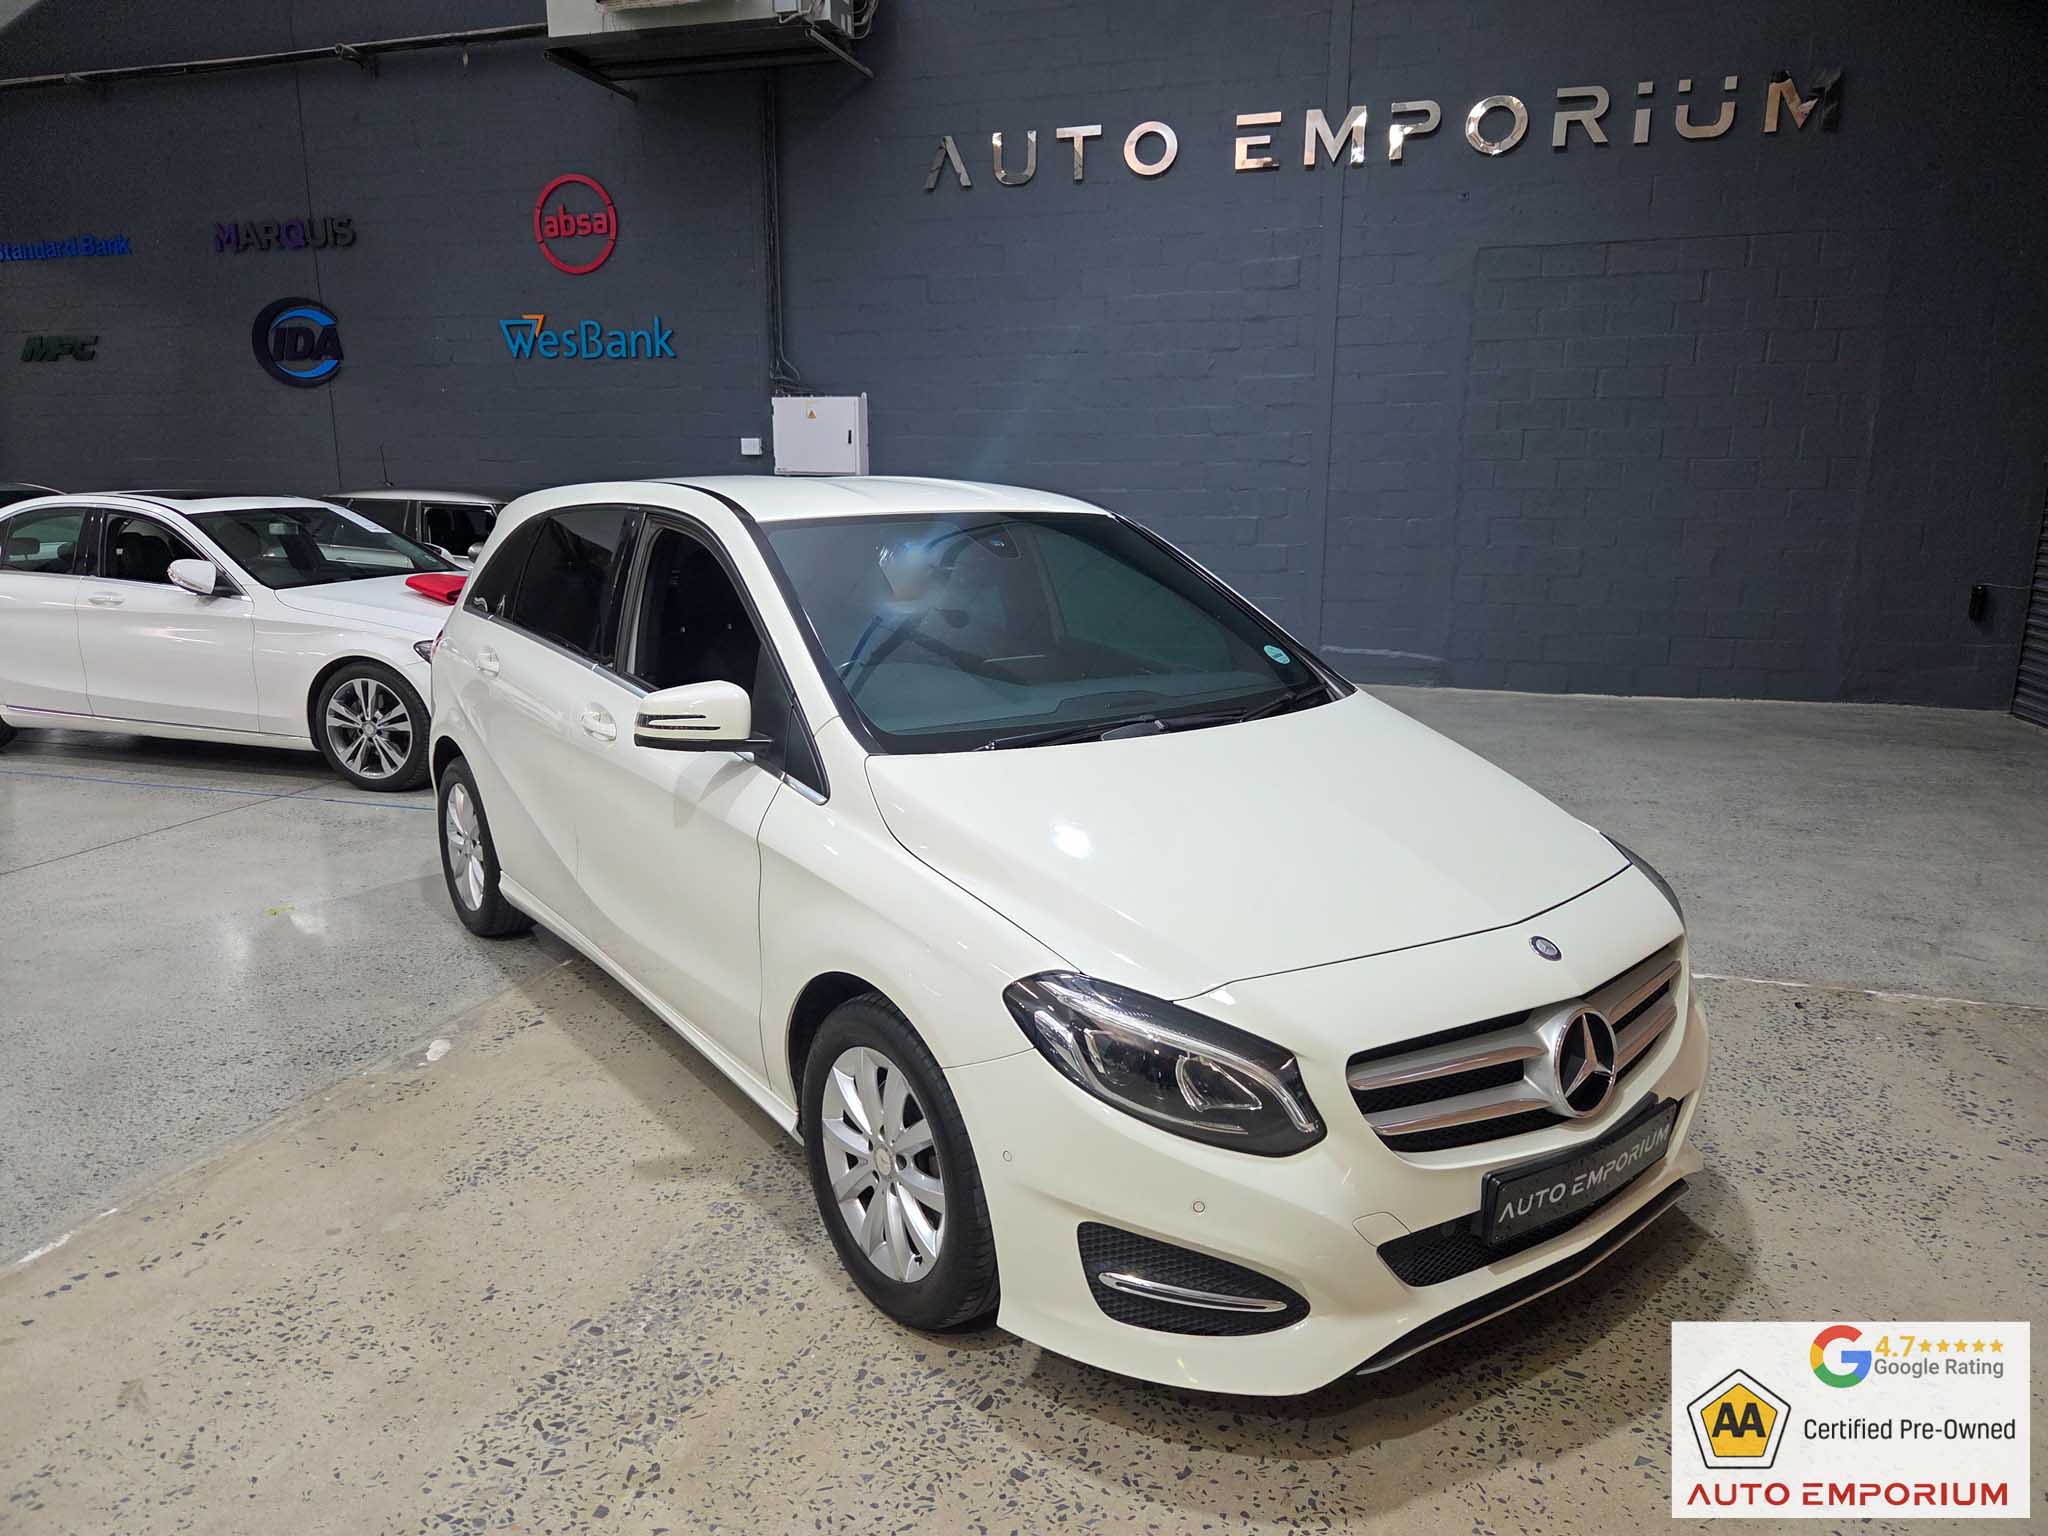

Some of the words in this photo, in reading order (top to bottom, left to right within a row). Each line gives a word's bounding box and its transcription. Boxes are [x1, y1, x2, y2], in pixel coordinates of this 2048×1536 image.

[925, 121, 1179, 190] AUTO
[213, 217, 356, 254] MARQUIS
[543, 203, 609, 238] absa
[80, 231, 132, 257] Bank
[499, 314, 678, 359] WesBank
[1498, 1182, 1567, 1224] AUTO
[1571, 1123, 1670, 1196] EMPORIUM
